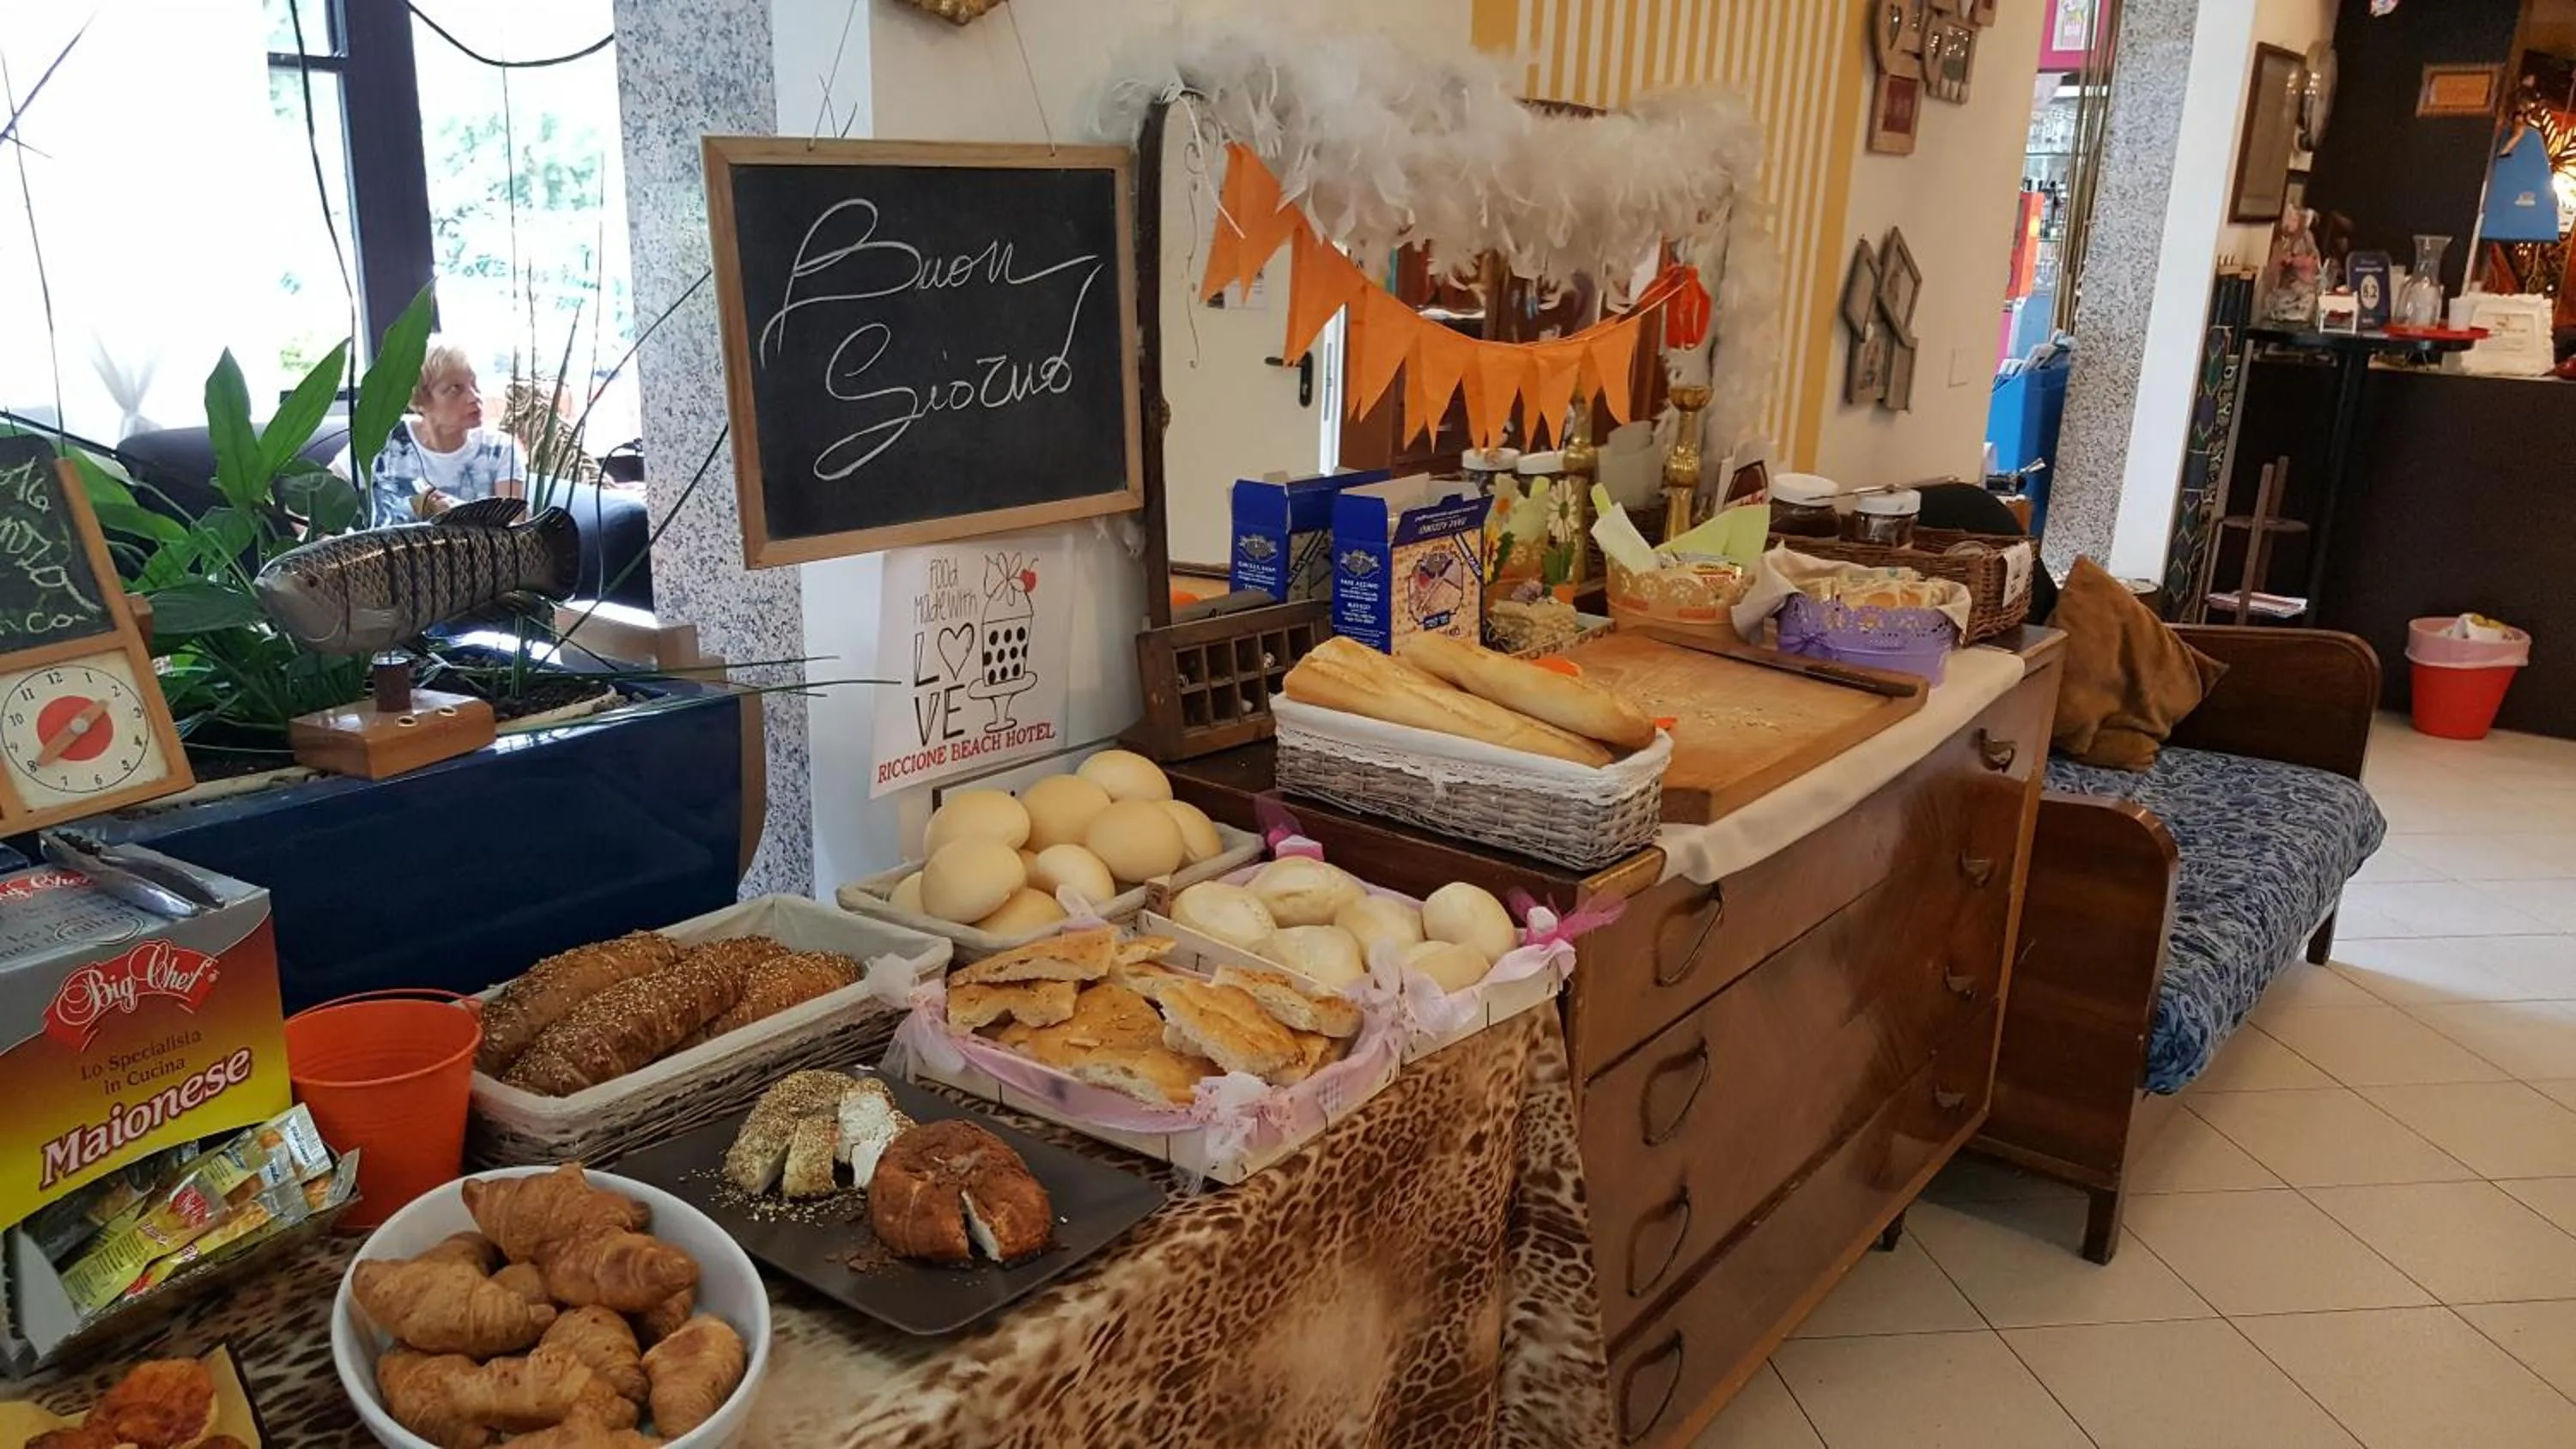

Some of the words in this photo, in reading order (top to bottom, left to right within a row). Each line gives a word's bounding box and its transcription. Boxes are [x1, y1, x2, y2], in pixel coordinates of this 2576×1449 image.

[761, 198, 1099, 370] Buon
[46, 672, 64, 685] 12
[85, 672, 93, 684] 1
[20, 688, 35, 701] 11
[112, 685, 121, 697] 2
[133, 706, 143, 718] 3
[8, 712, 24, 727] 10
[134, 734, 143, 748] 4
[878, 743, 947, 784] RICCIONE
[951, 732, 1001, 761] BEACH
[1006, 722, 1056, 748] HOTEL
[121, 759, 131, 772] 5
[94, 773, 102, 785] 6
[56, 967, 136, 1026] Big
[128, 942, 219, 993] Chef
[82, 1063, 103, 1081] Lo
[107, 1029, 203, 1071] Specialista
[104, 1079, 121, 1095] in
[128, 1057, 185, 1087] Cucina
[39, 1047, 252, 1191] Maionese
